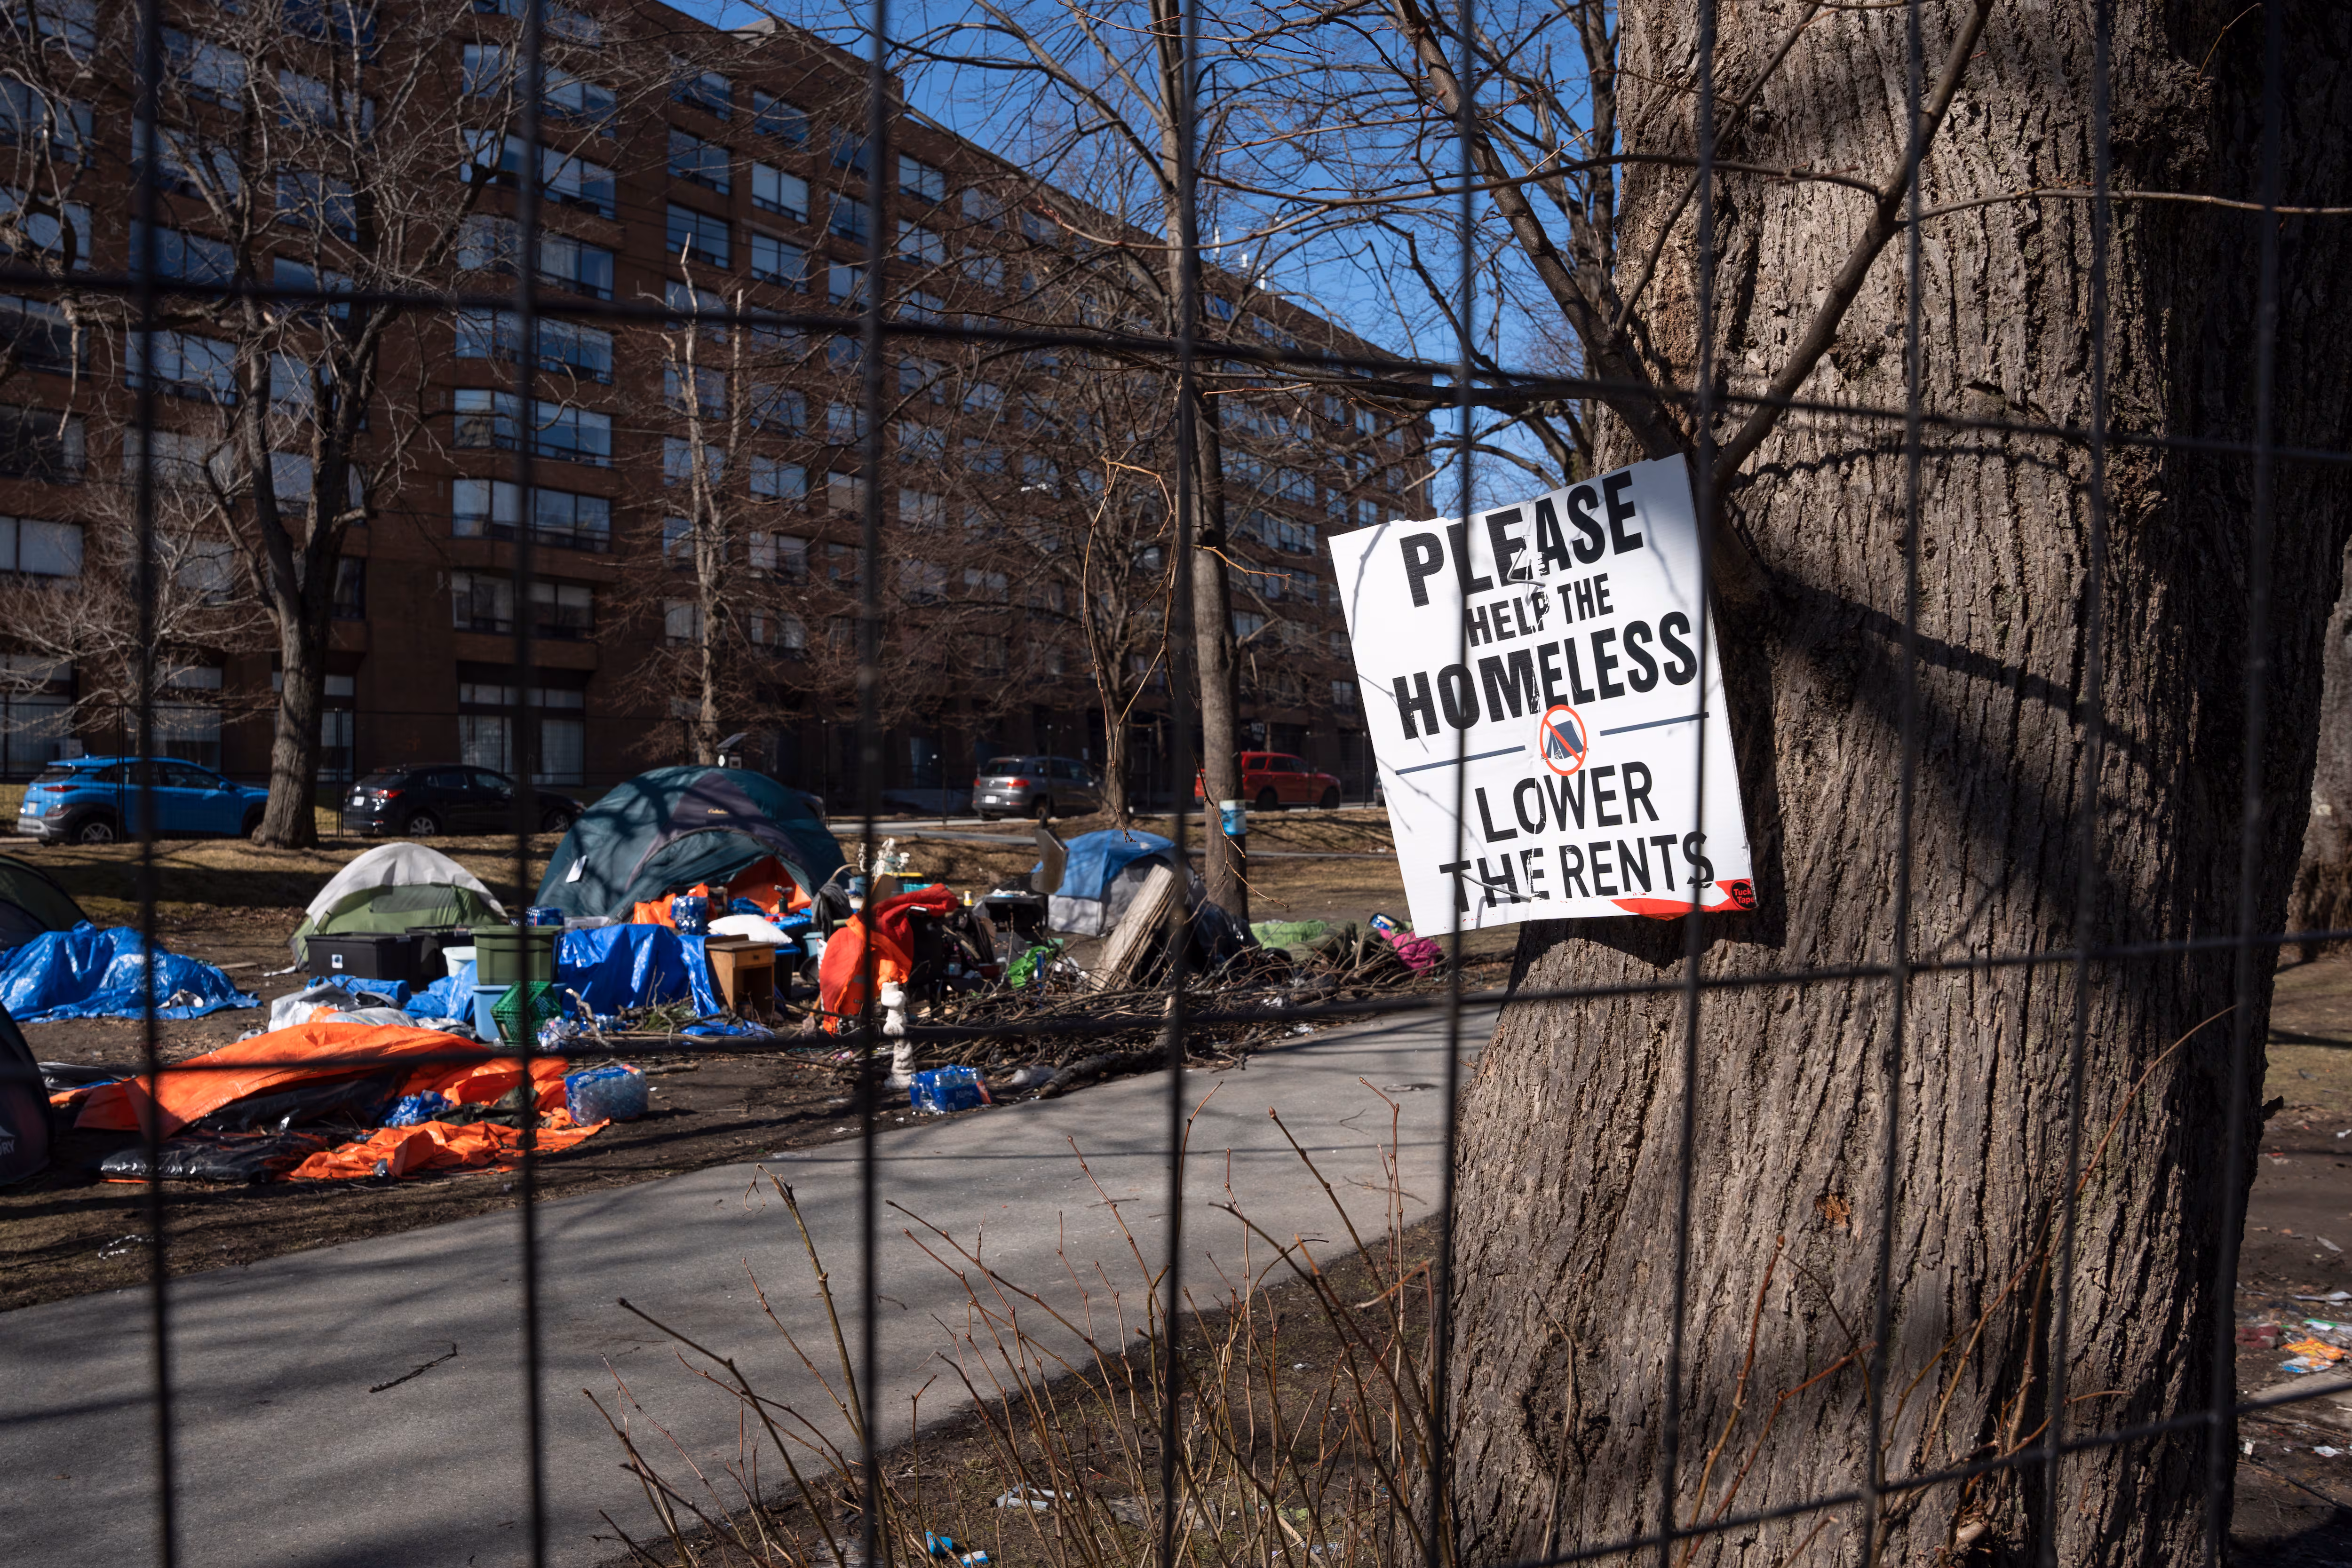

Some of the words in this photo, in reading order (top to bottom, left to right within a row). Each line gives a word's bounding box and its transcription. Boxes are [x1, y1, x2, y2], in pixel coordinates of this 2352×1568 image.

[1399, 470, 1644, 608] PLEASE
[1465, 591, 1550, 647] HELP
[1557, 572, 1614, 624] THE
[1392, 611, 1697, 740] HOMELESS
[1475, 761, 1660, 843] LOWER
[1439, 847, 1550, 912] THE
[1558, 831, 1715, 899] RENTS
[1733, 887, 1752, 896] Tuck
[1737, 896, 1754, 904] Tape
